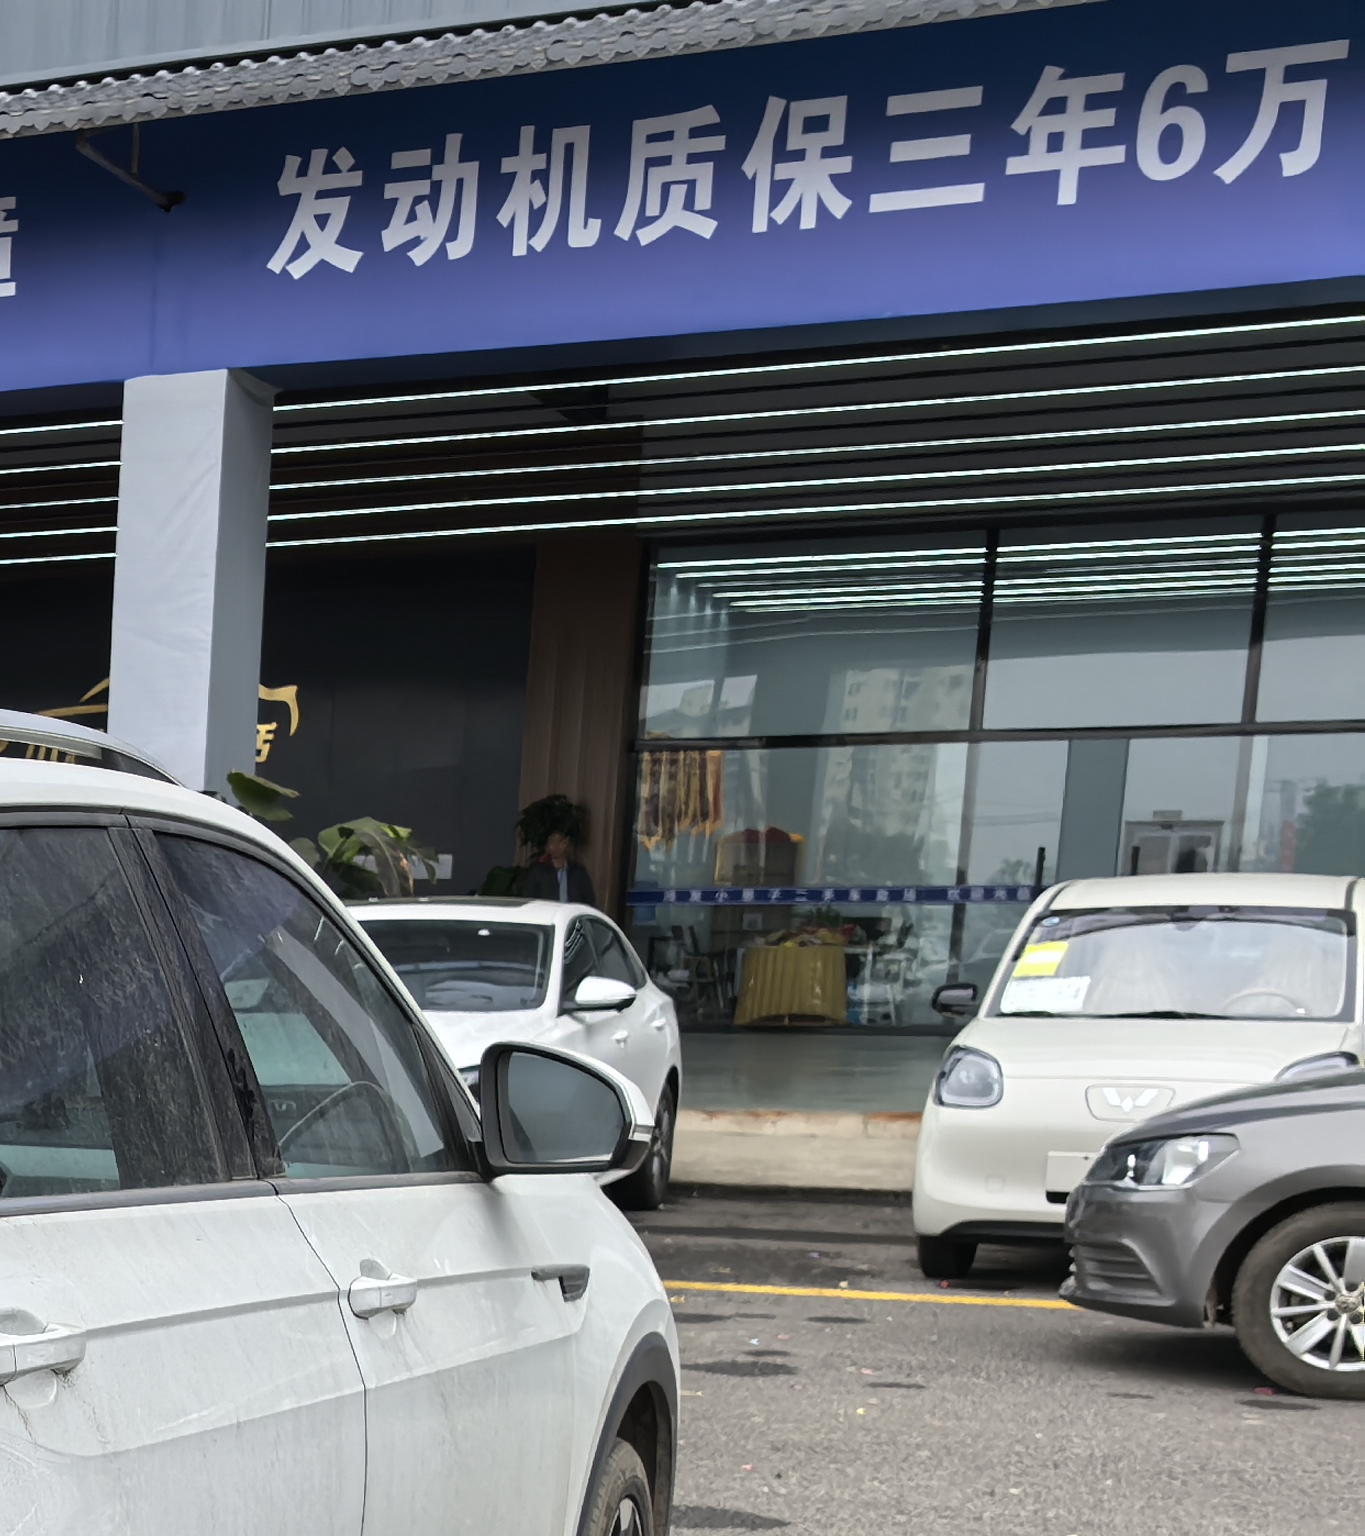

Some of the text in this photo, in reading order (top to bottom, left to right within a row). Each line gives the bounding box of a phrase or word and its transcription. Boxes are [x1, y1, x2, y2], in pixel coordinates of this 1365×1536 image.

[266, 38, 1350, 279] 发动机质保三年6万
